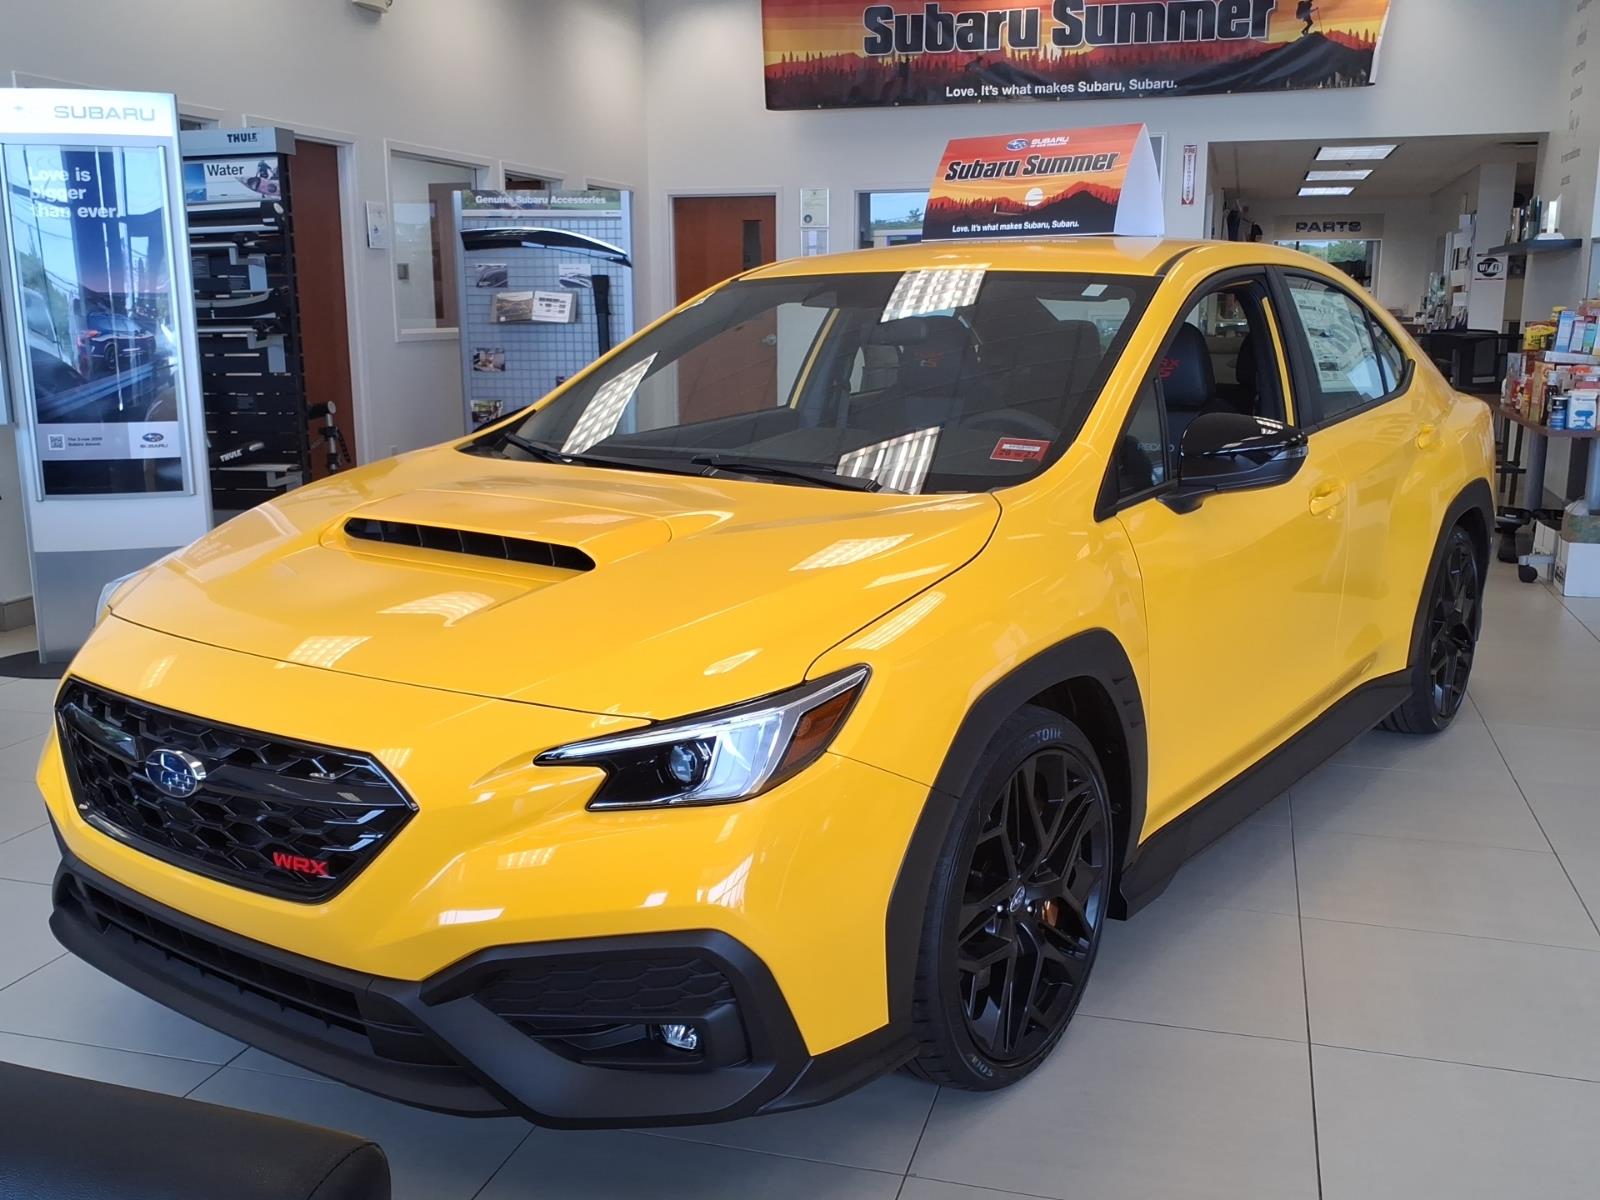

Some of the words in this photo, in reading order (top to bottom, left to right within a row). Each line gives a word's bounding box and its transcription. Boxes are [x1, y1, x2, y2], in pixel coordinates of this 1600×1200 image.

[863, 2, 1040, 56] Subaru
[1051, 0, 1276, 48] Summer
[945, 86, 978, 97] Love.
[981, 85, 999, 96] It's
[1001, 83, 1032, 96] what
[1034, 82, 1075, 94] makes
[1077, 81, 1125, 93] Subaru,
[1128, 78, 1178, 90] Subaru.
[54, 105, 156, 121] SUBARU
[226, 132, 258, 143] THULE
[1031, 136, 1070, 145] SUBARU
[29, 166, 69, 181] Love
[75, 167, 92, 182] is
[206, 164, 245, 177] Water
[944, 158, 1021, 181] Subaru
[1023, 152, 1120, 177] Summer
[30, 183, 87, 203] bigger
[475, 195, 513, 204] Genuine
[514, 195, 549, 204] Subaru
[550, 195, 607, 204] Accessories
[952, 225, 970, 233] Love.
[982, 222, 999, 231] what
[1000, 221, 1022, 230] makes
[1023, 221, 1051, 230] Subaru,
[1051, 219, 1080, 229] Subaru.
[1295, 221, 1361, 233] PARTS
[219, 448, 245, 462] THULE
[272, 851, 329, 876] WRX
